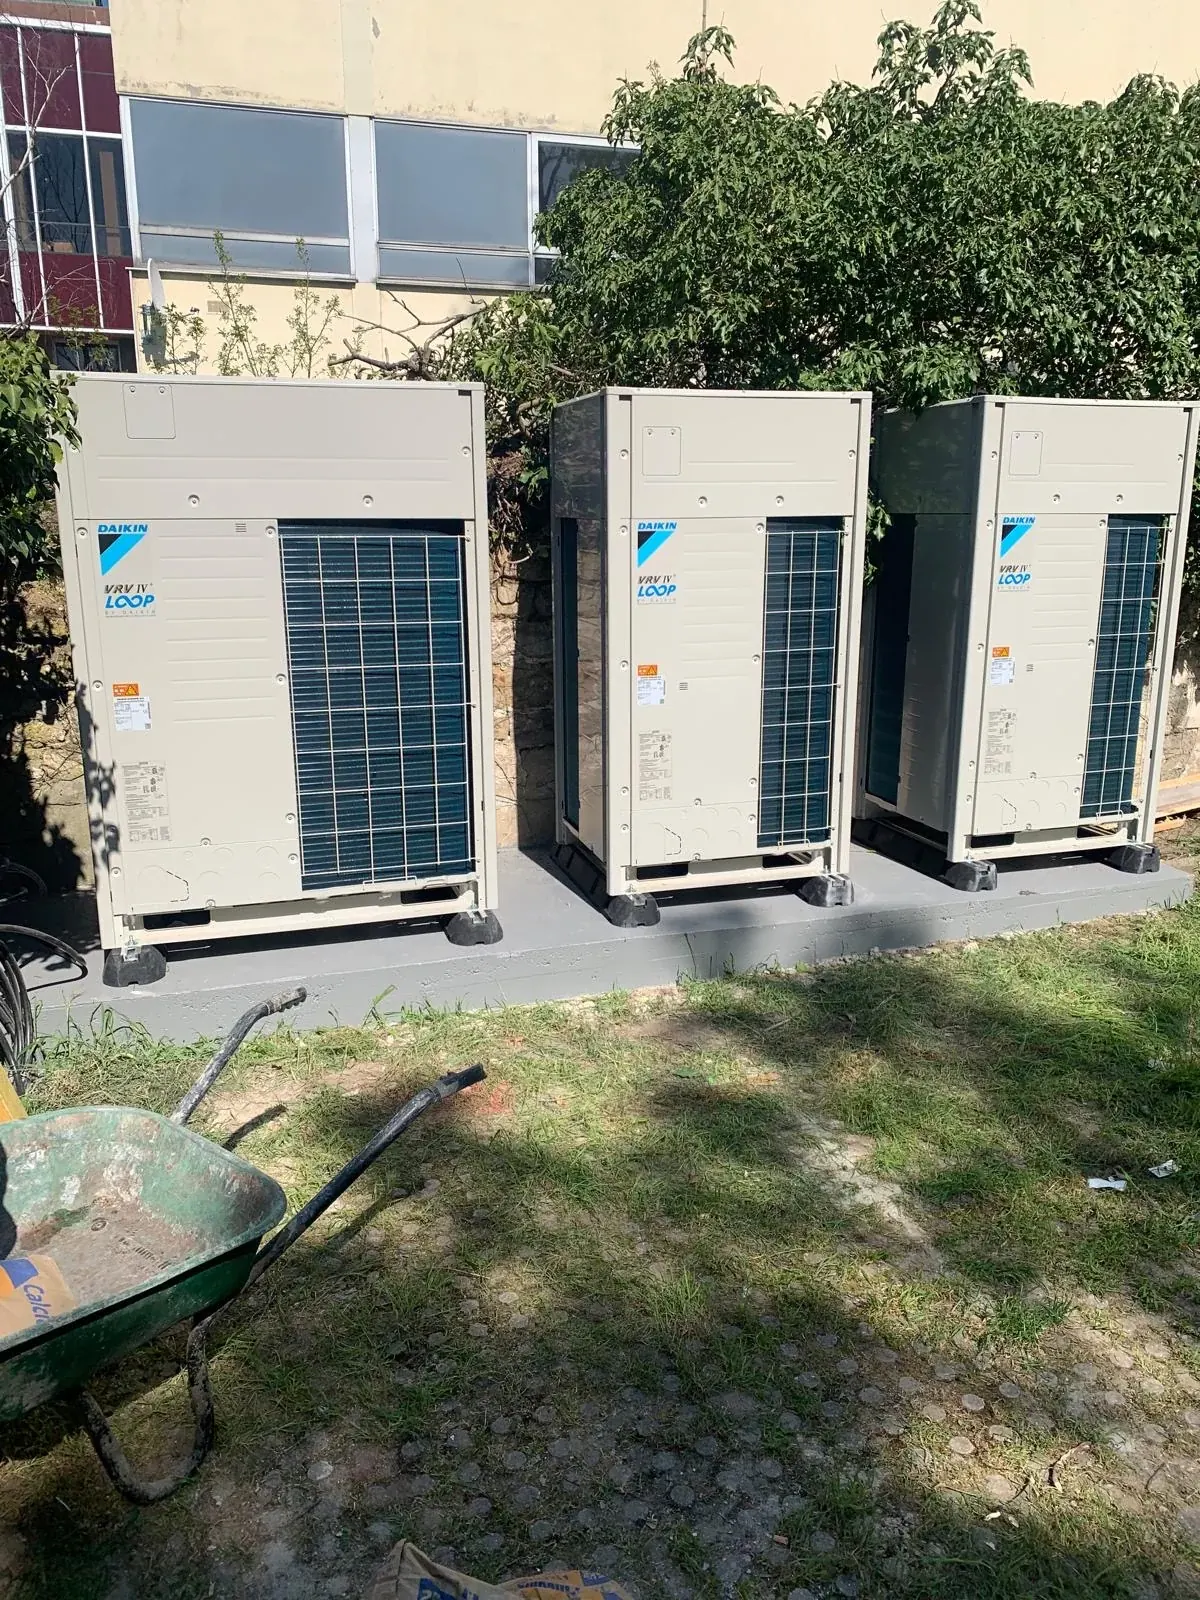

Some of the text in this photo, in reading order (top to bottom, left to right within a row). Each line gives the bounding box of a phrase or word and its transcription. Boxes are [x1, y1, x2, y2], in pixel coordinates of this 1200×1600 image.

[1002, 516, 1036, 524] DAIKIN
[97, 524, 149, 533] DAIKIN
[637, 521, 678, 530] DAIKIN
[999, 565, 1020, 573] VRV
[637, 575, 662, 585] VRV
[998, 573, 1032, 585] LOOP
[103, 584, 135, 595] VRV
[637, 584, 677, 598] LOOP
[104, 594, 156, 609] LOOP
